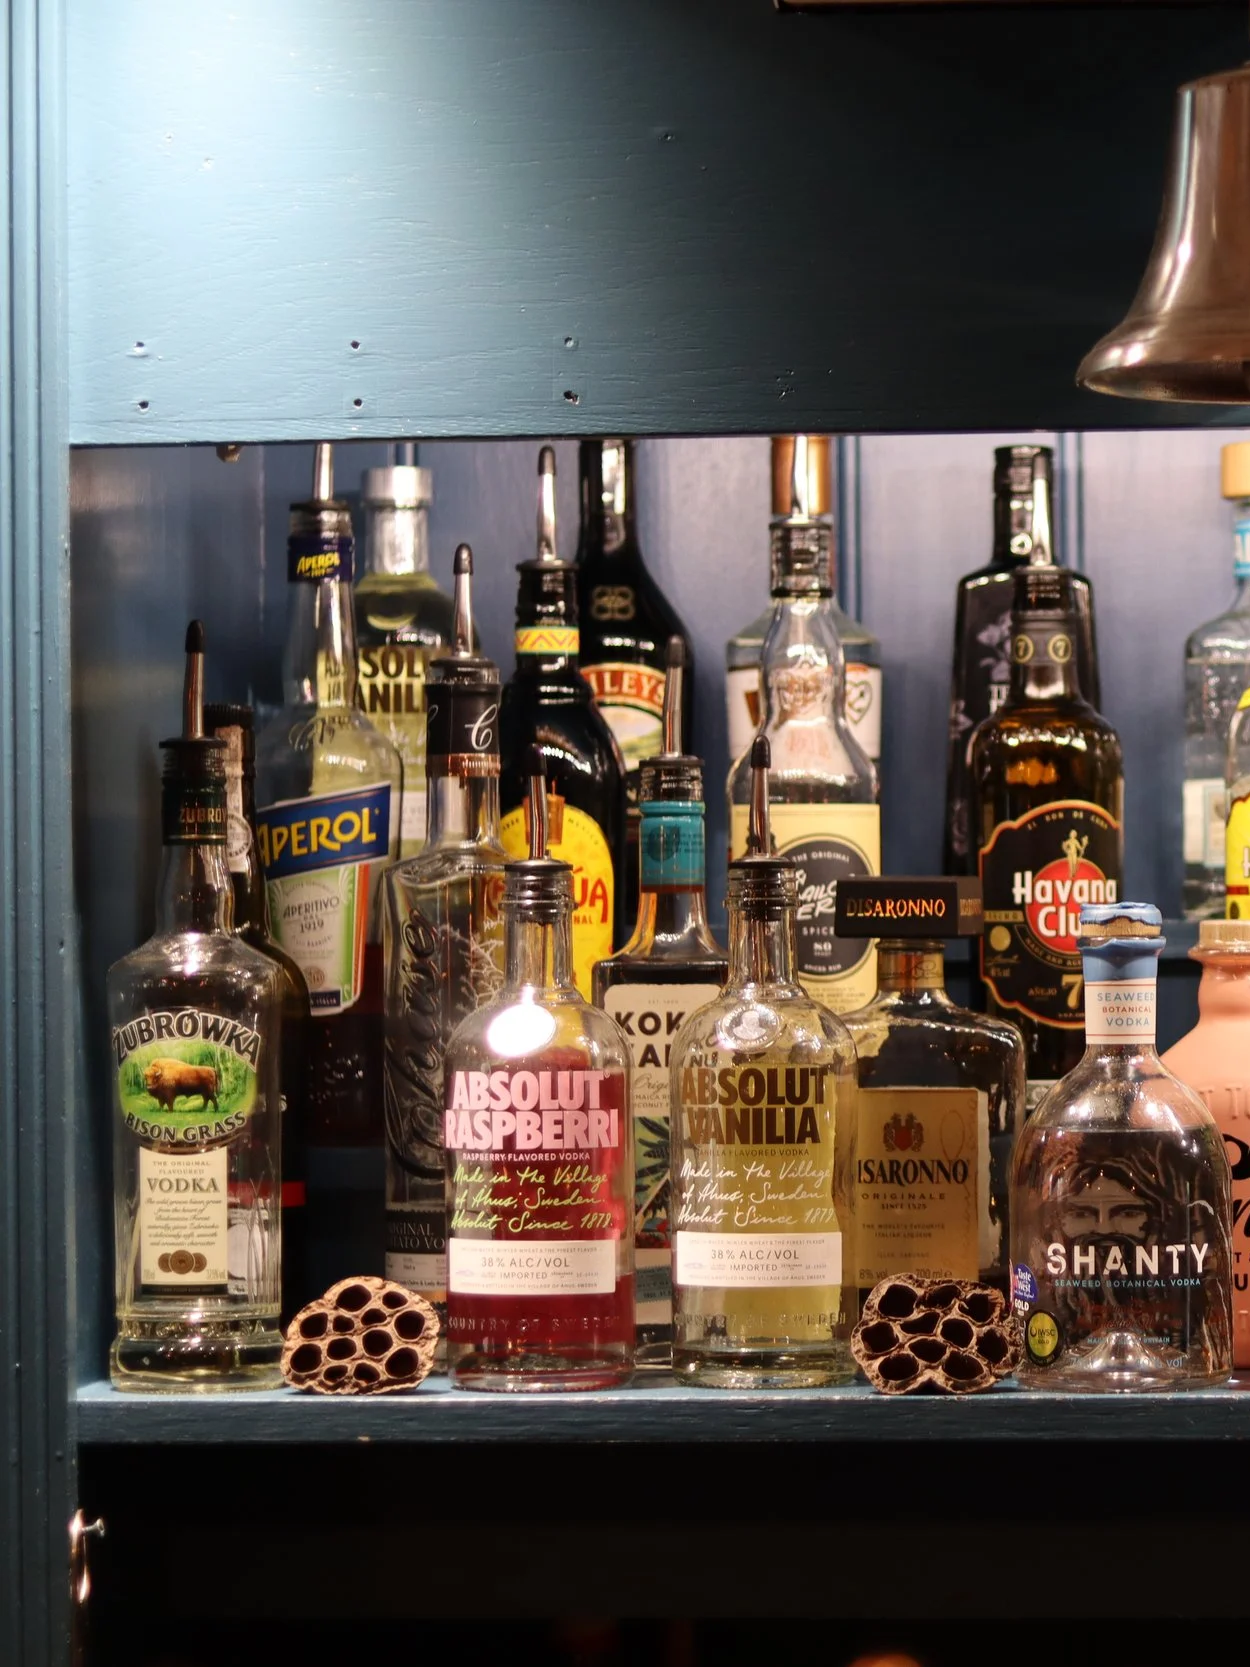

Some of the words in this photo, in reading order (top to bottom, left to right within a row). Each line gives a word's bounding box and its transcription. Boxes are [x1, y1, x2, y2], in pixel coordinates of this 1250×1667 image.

[257, 807, 377, 868] APEROL
[1012, 870, 1117, 905] Havana
[846, 898, 946, 919] DISARONNO
[300, 919, 325, 933] 1919
[1061, 973, 1084, 1010] 7
[1097, 991, 1155, 1003] SEAWEED
[1102, 1006, 1151, 1014] BOTANICAL
[1106, 1016, 1150, 1027] VODKA
[452, 1070, 604, 1111] ABSOLUT
[681, 1067, 829, 1105] ABSOLUT
[125, 1111, 177, 1143] BISON
[182, 1111, 247, 1144] GRASS
[445, 1108, 619, 1150] RASPBERRI
[686, 1107, 821, 1145] VANILIA
[559, 1151, 591, 1161] VODKA
[779, 1148, 810, 1157] VODKA
[453, 1163, 485, 1184] Made
[489, 1170, 512, 1184] in
[516, 1165, 546, 1187] the
[553, 1164, 608, 1194] Village
[680, 1158, 712, 1179] Made
[716, 1165, 738, 1178] in
[742, 1160, 771, 1181] the
[779, 1159, 830, 1187] Village
[147, 1177, 221, 1194] VODKA
[681, 1183, 695, 1201] of
[455, 1192, 469, 1207] of
[861, 1192, 946, 1201] ORIGINALE
[451, 1209, 502, 1231] Absolut
[507, 1210, 574, 1234] Since
[677, 1202, 728, 1224] Absolut
[734, 1203, 798, 1227] Since
[739, 1249, 800, 1260] ALC/VOL
[1046, 1242, 1209, 1276] SHANTY
[500, 1270, 548, 1280] IMPORTED
[730, 1263, 778, 1272] IMPORTED
[1054, 1280, 1101, 1288] SEAWEED
[1106, 1279, 1166, 1288] BOTANICAL
[1170, 1277, 1201, 1287] VODKA
[1014, 1299, 1030, 1312] GOLD
[1037, 1328, 1056, 1337] IWSC
[1166, 1356, 1183, 1368] vol
